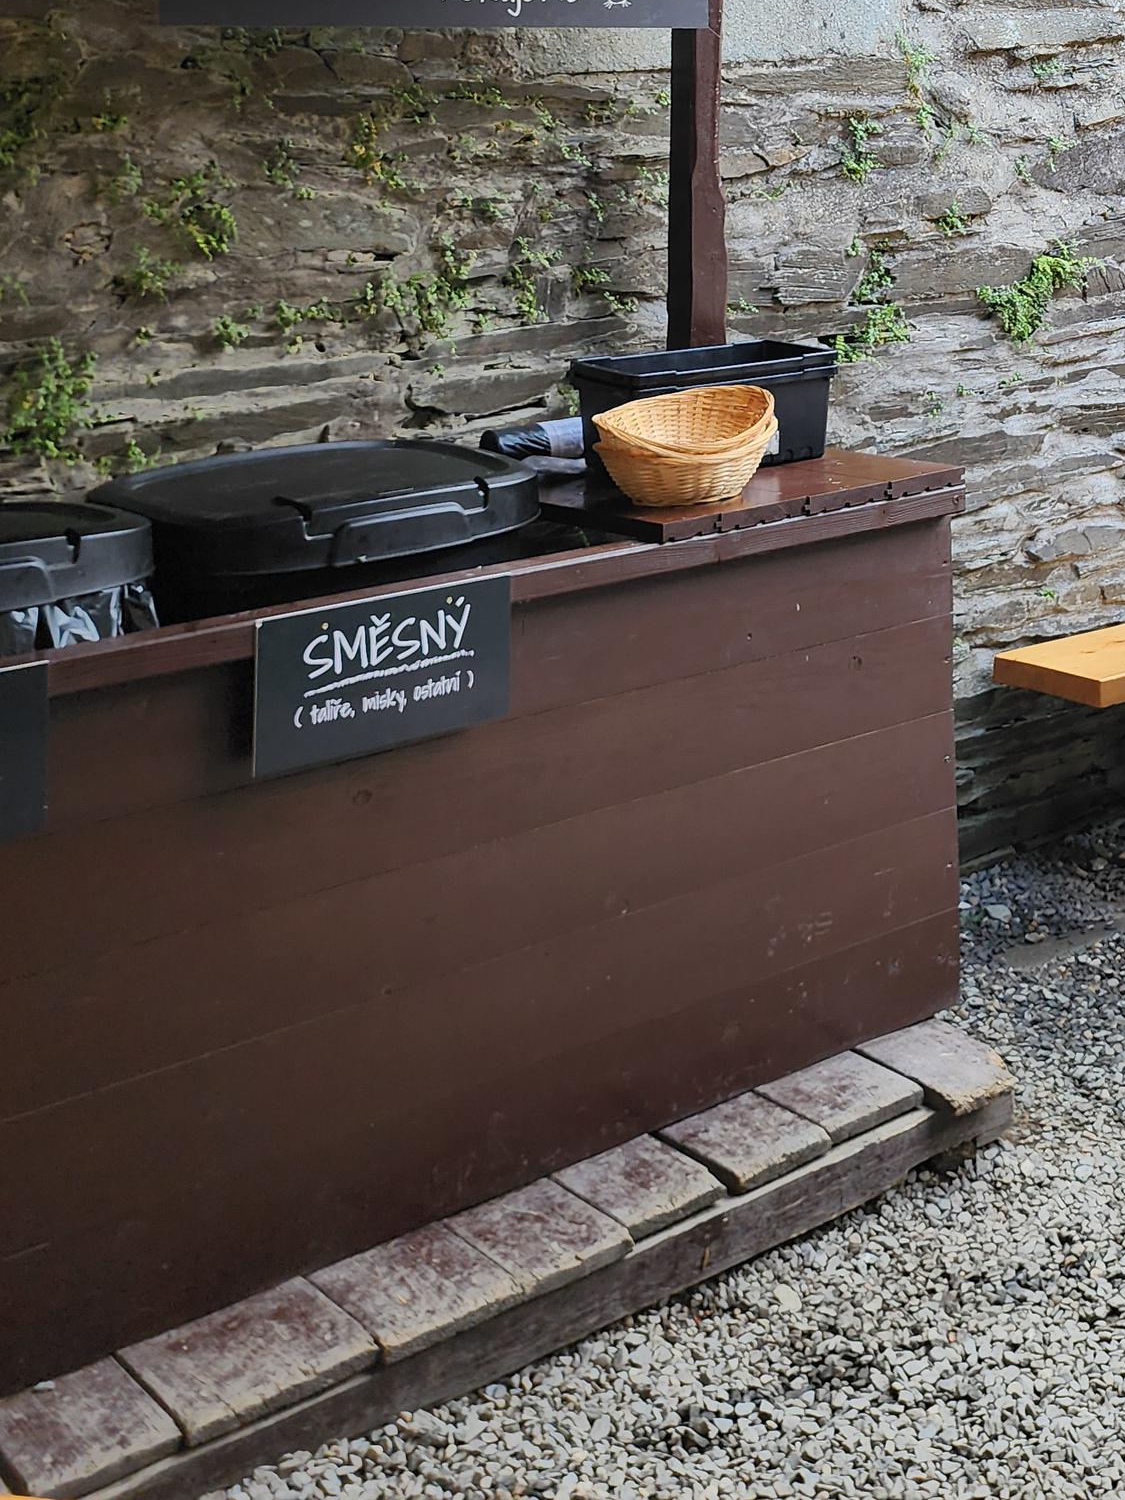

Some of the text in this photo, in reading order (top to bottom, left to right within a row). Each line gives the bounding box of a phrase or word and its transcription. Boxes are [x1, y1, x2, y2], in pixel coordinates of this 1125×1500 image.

[302, 595, 472, 680] SMĚSNÝ
[362, 687, 408, 713] misky,
[412, 670, 462, 702] ostatní
